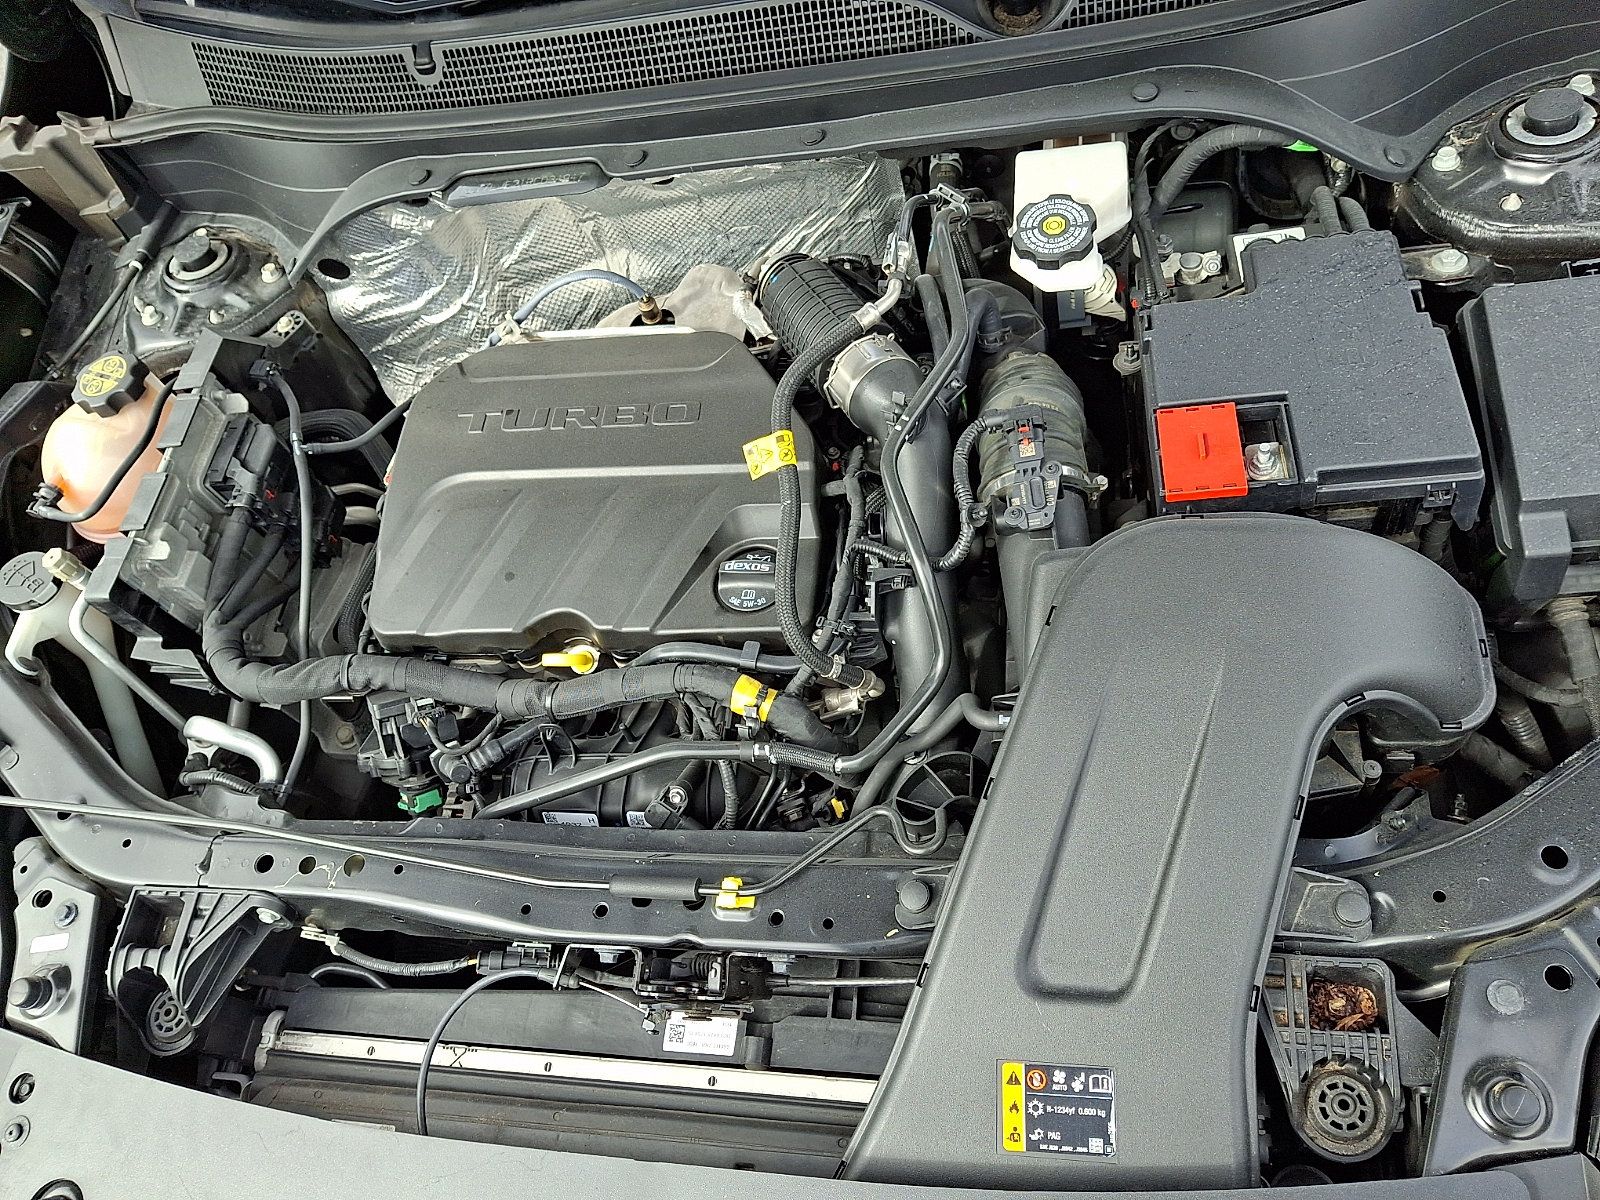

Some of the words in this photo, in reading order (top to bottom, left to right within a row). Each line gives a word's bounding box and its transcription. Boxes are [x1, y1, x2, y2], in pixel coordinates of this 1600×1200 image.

[457, 402, 701, 433] TURBO
[724, 560, 772, 572] dexos
[743, 597, 767, 608] 5W-30
[1046, 1105, 1076, 1116] R-1234yf
[1097, 1108, 1106, 1118] kg
[1047, 1131, 1061, 1141] PAG
